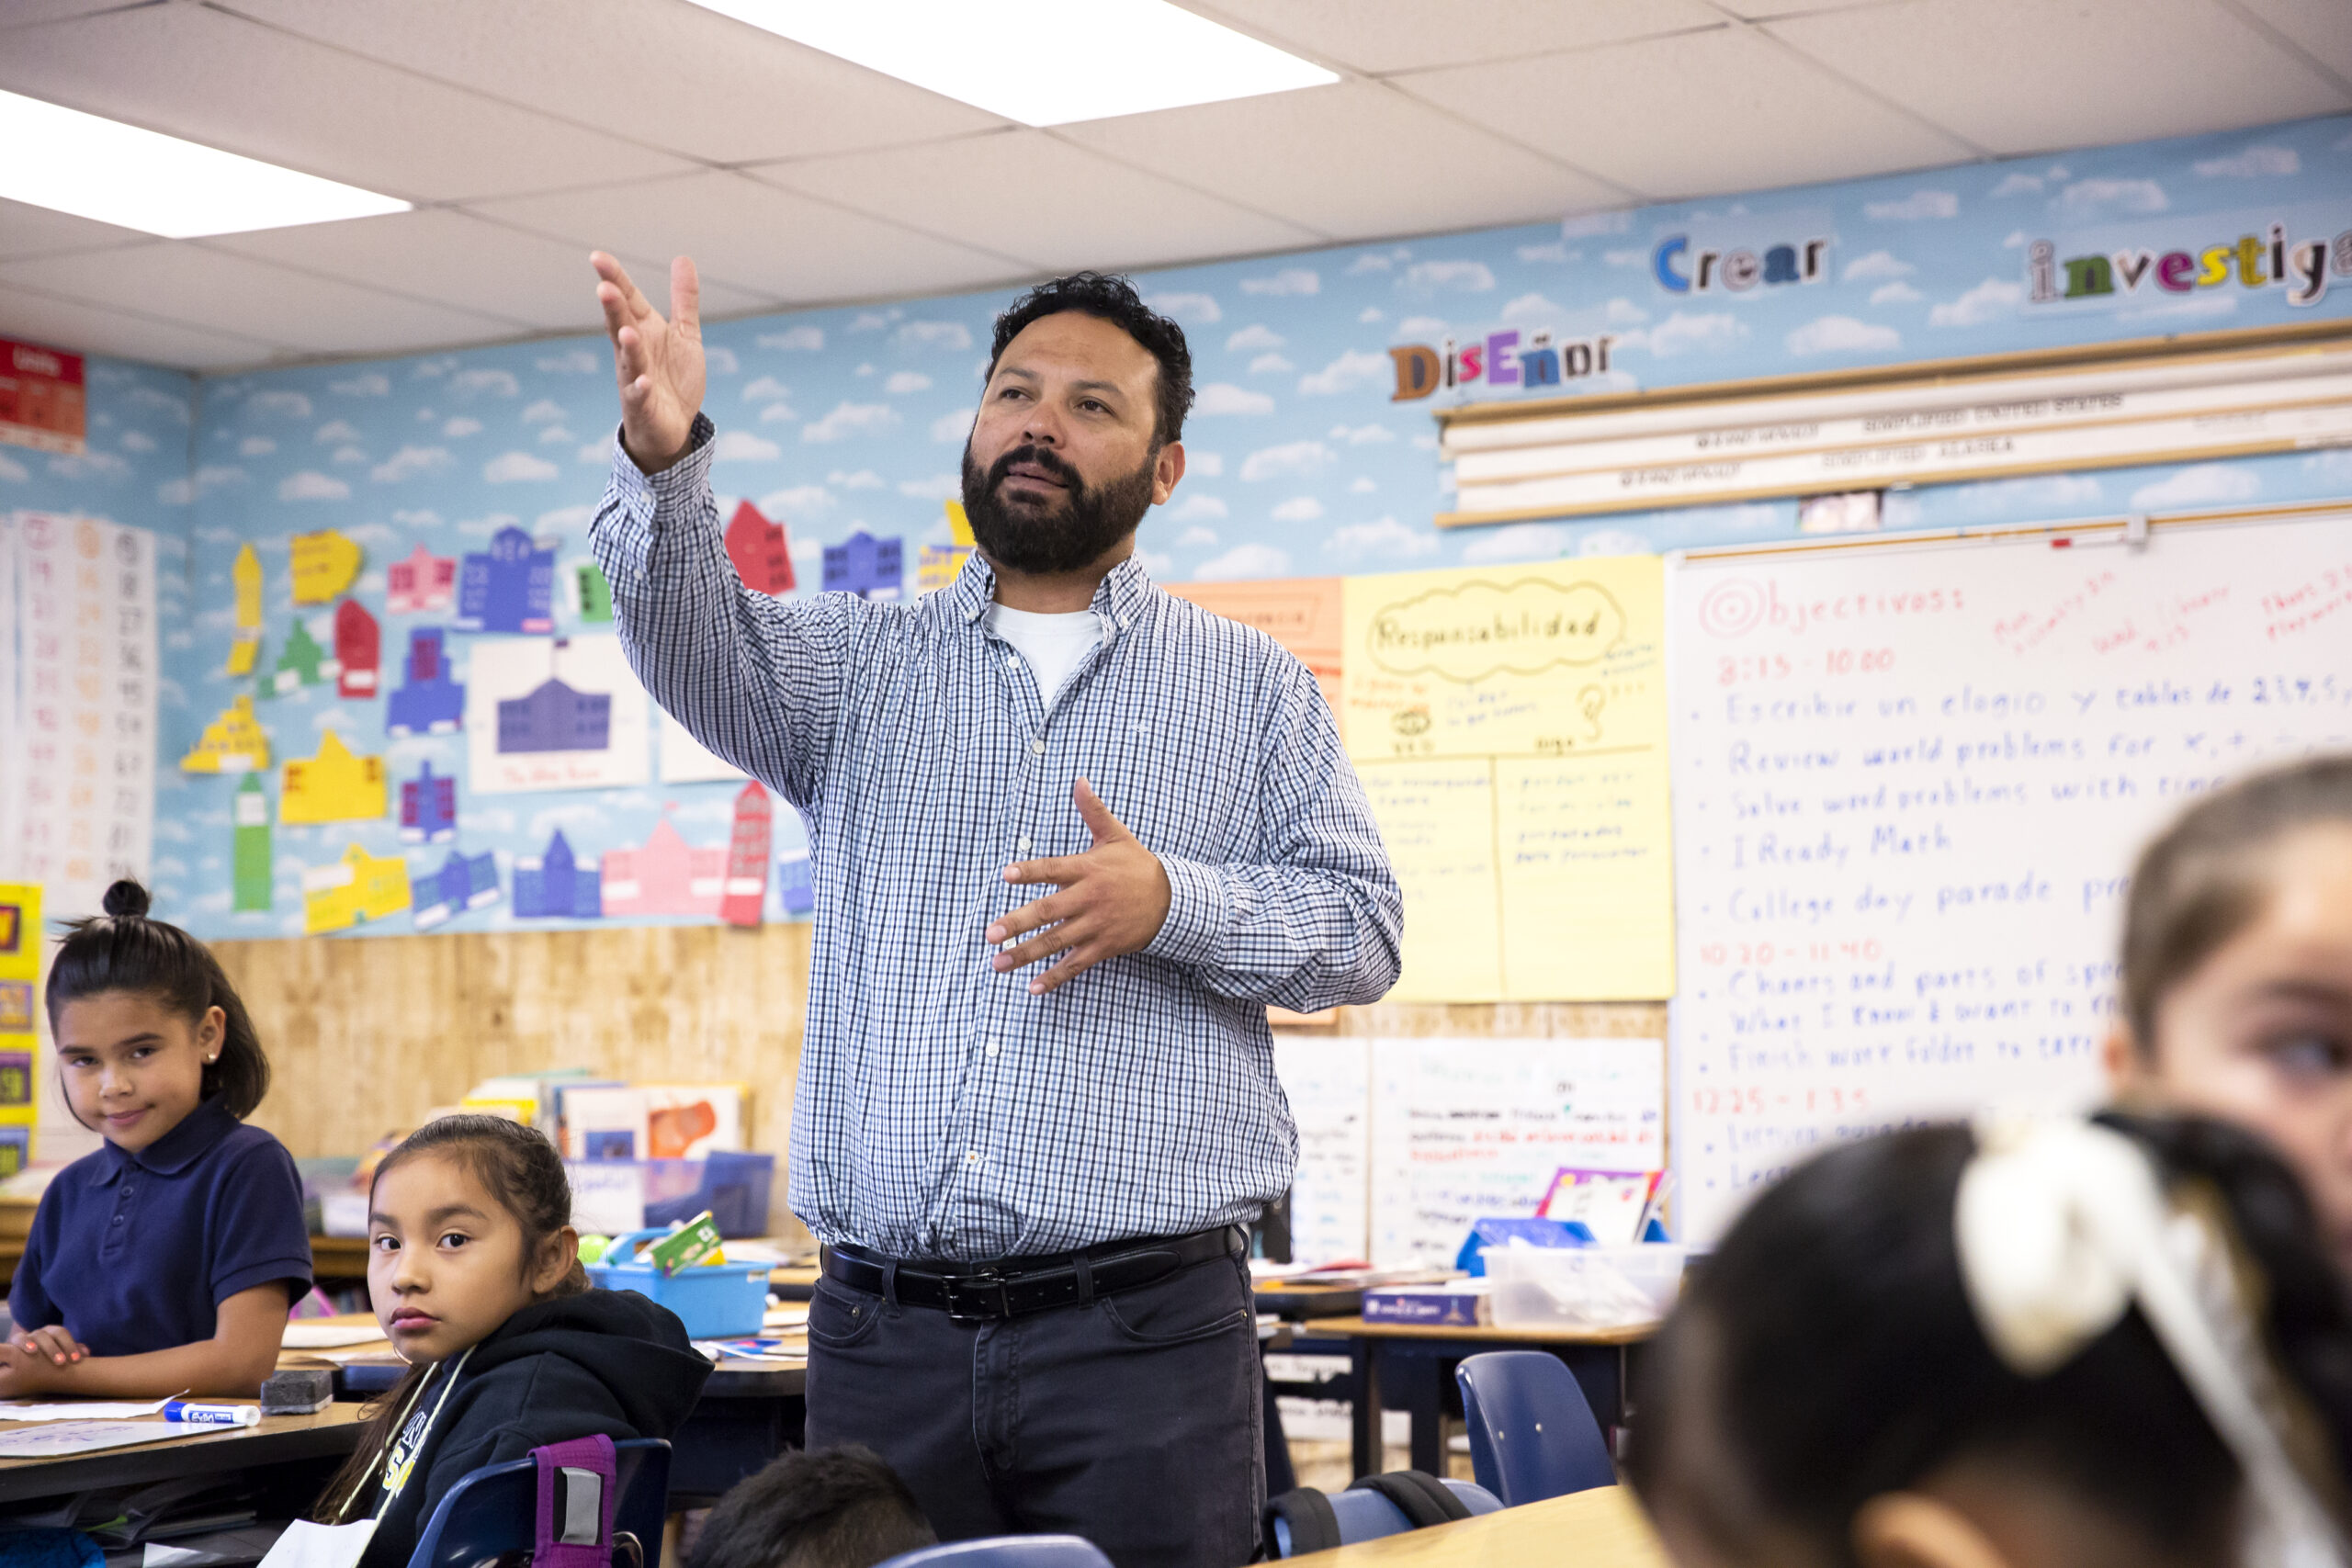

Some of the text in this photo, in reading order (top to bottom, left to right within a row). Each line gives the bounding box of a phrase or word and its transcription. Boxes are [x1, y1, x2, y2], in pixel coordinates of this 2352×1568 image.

[1654, 233, 1828, 293] Crear
[1377, 610, 1601, 653] Responsabilidad
[1726, 691, 1859, 727] Escribir
[1879, 694, 1917, 718] un
[1940, 683, 2048, 724] elogio
[2206, 678, 2233, 705] de
[1728, 739, 1841, 775] Review
[1956, 730, 2086, 770] problems
[2108, 731, 2158, 759] for
[1730, 785, 1803, 822] Solve
[1897, 777, 2029, 816] problems
[2051, 773, 2139, 802] with
[1758, 830, 1850, 870] Ready
[1870, 821, 1953, 857] Math
[1728, 886, 1836, 924] College
[1854, 882, 1917, 924] day
[1937, 870, 2053, 915] parade
[1849, 960, 1895, 991] and
[2016, 956, 2049, 986] of
